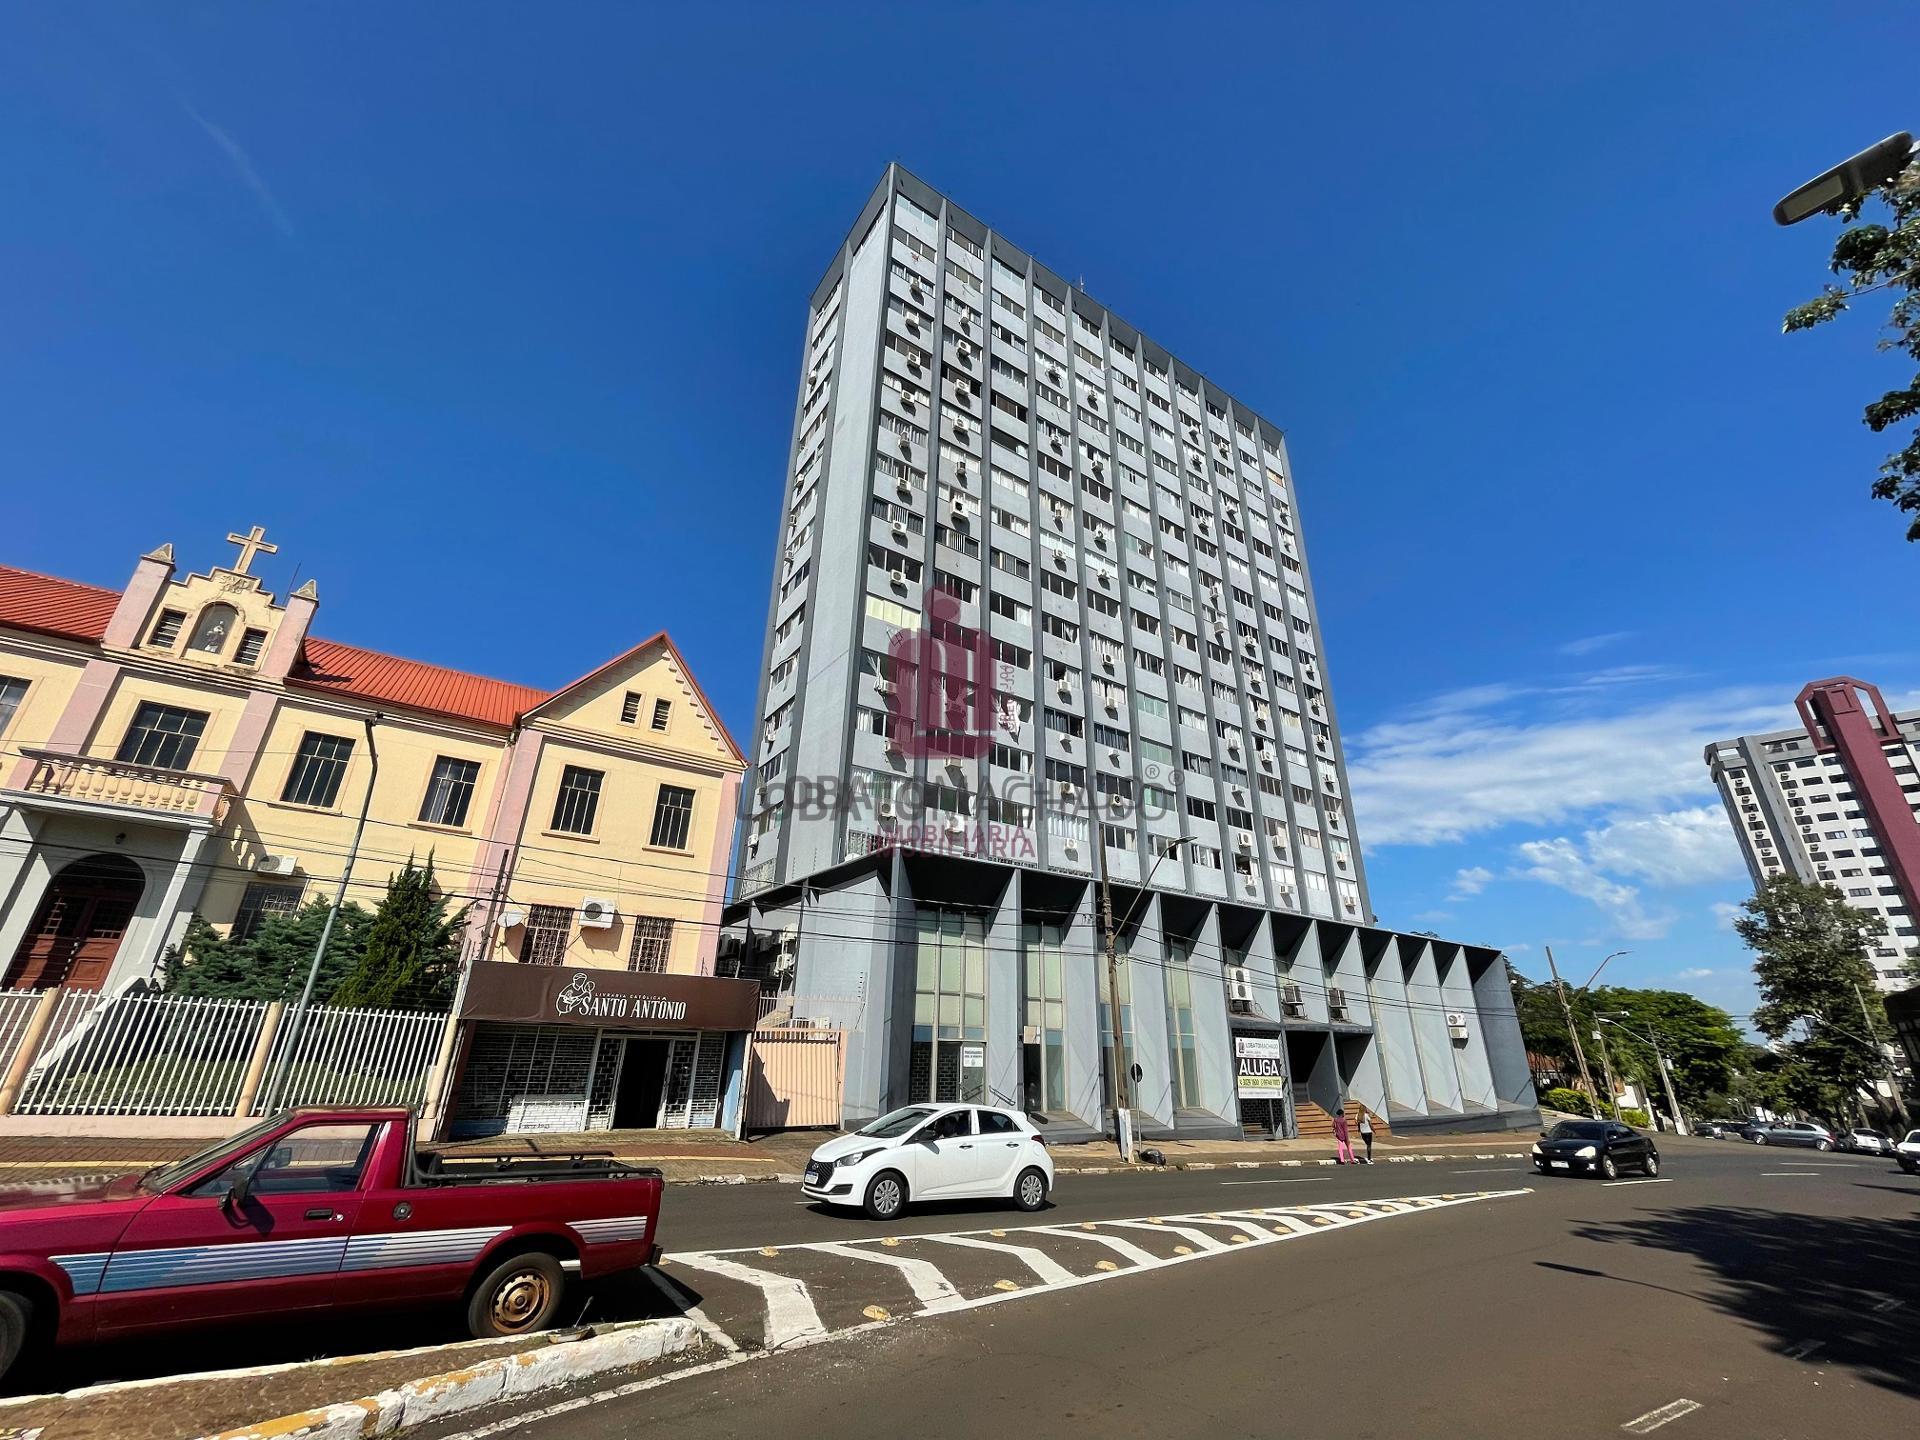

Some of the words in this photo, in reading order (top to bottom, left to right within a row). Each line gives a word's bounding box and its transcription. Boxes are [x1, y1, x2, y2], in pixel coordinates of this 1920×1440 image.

[579, 996, 627, 1017] SANTO
[630, 996, 687, 1020] ANTÔNIO
[1239, 1059, 1279, 1075] ALUGA
